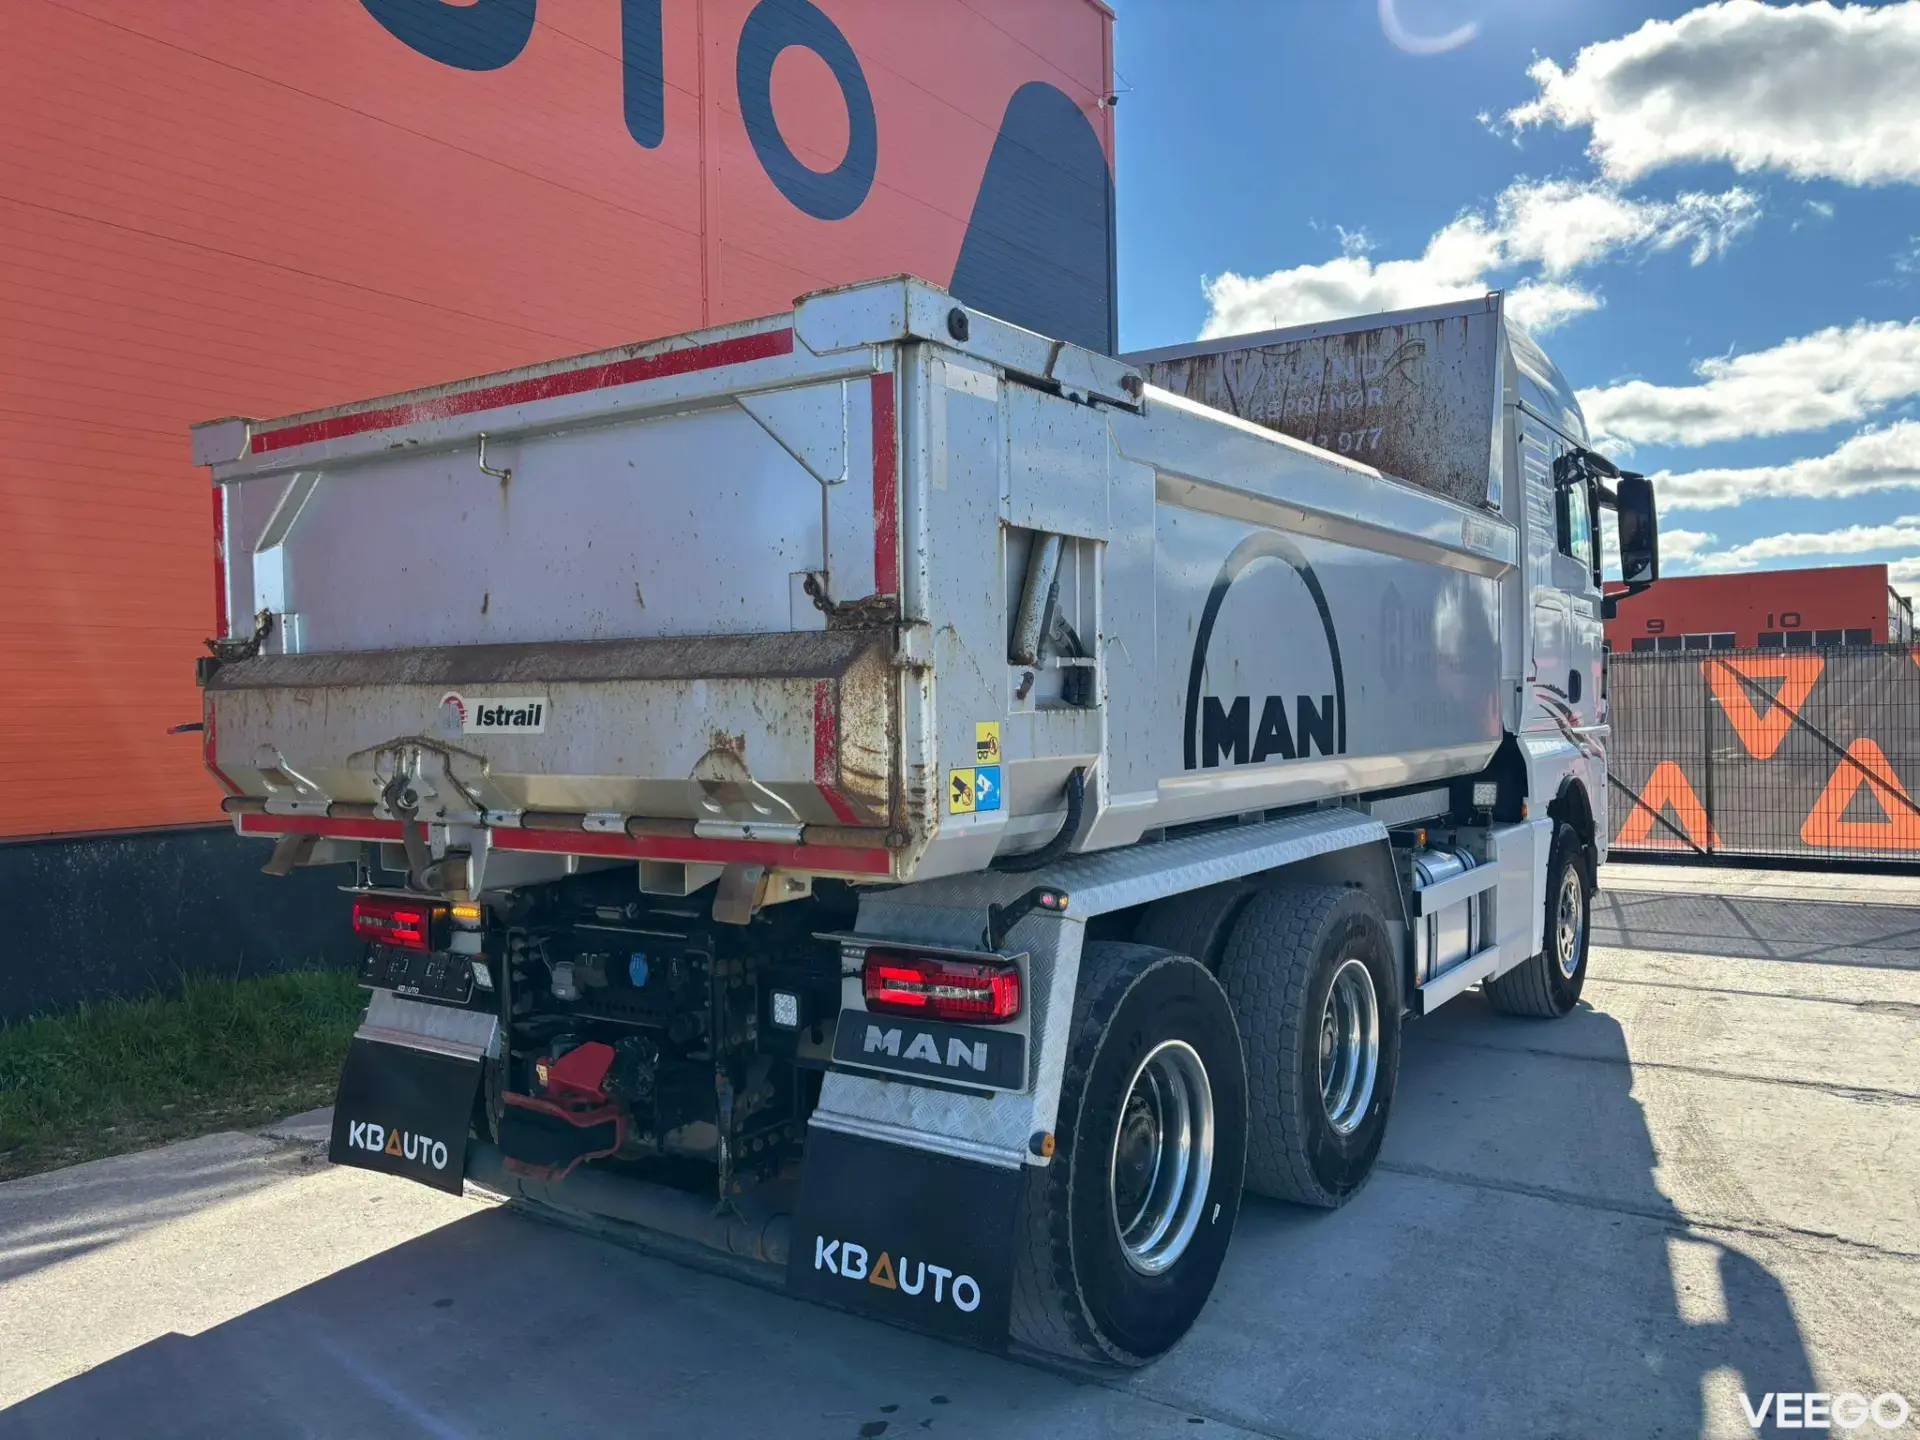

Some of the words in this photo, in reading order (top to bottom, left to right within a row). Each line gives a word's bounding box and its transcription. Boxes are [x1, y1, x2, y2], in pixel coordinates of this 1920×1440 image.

[1646, 618, 1665, 634] 9
[1767, 612, 1801, 629] 10
[476, 703, 542, 726] Istrail
[1202, 695, 1334, 768] MAN
[863, 1024, 988, 1072] MAN
[349, 1120, 448, 1170] KBAUTO
[814, 1235, 981, 1312] KBAUTO
